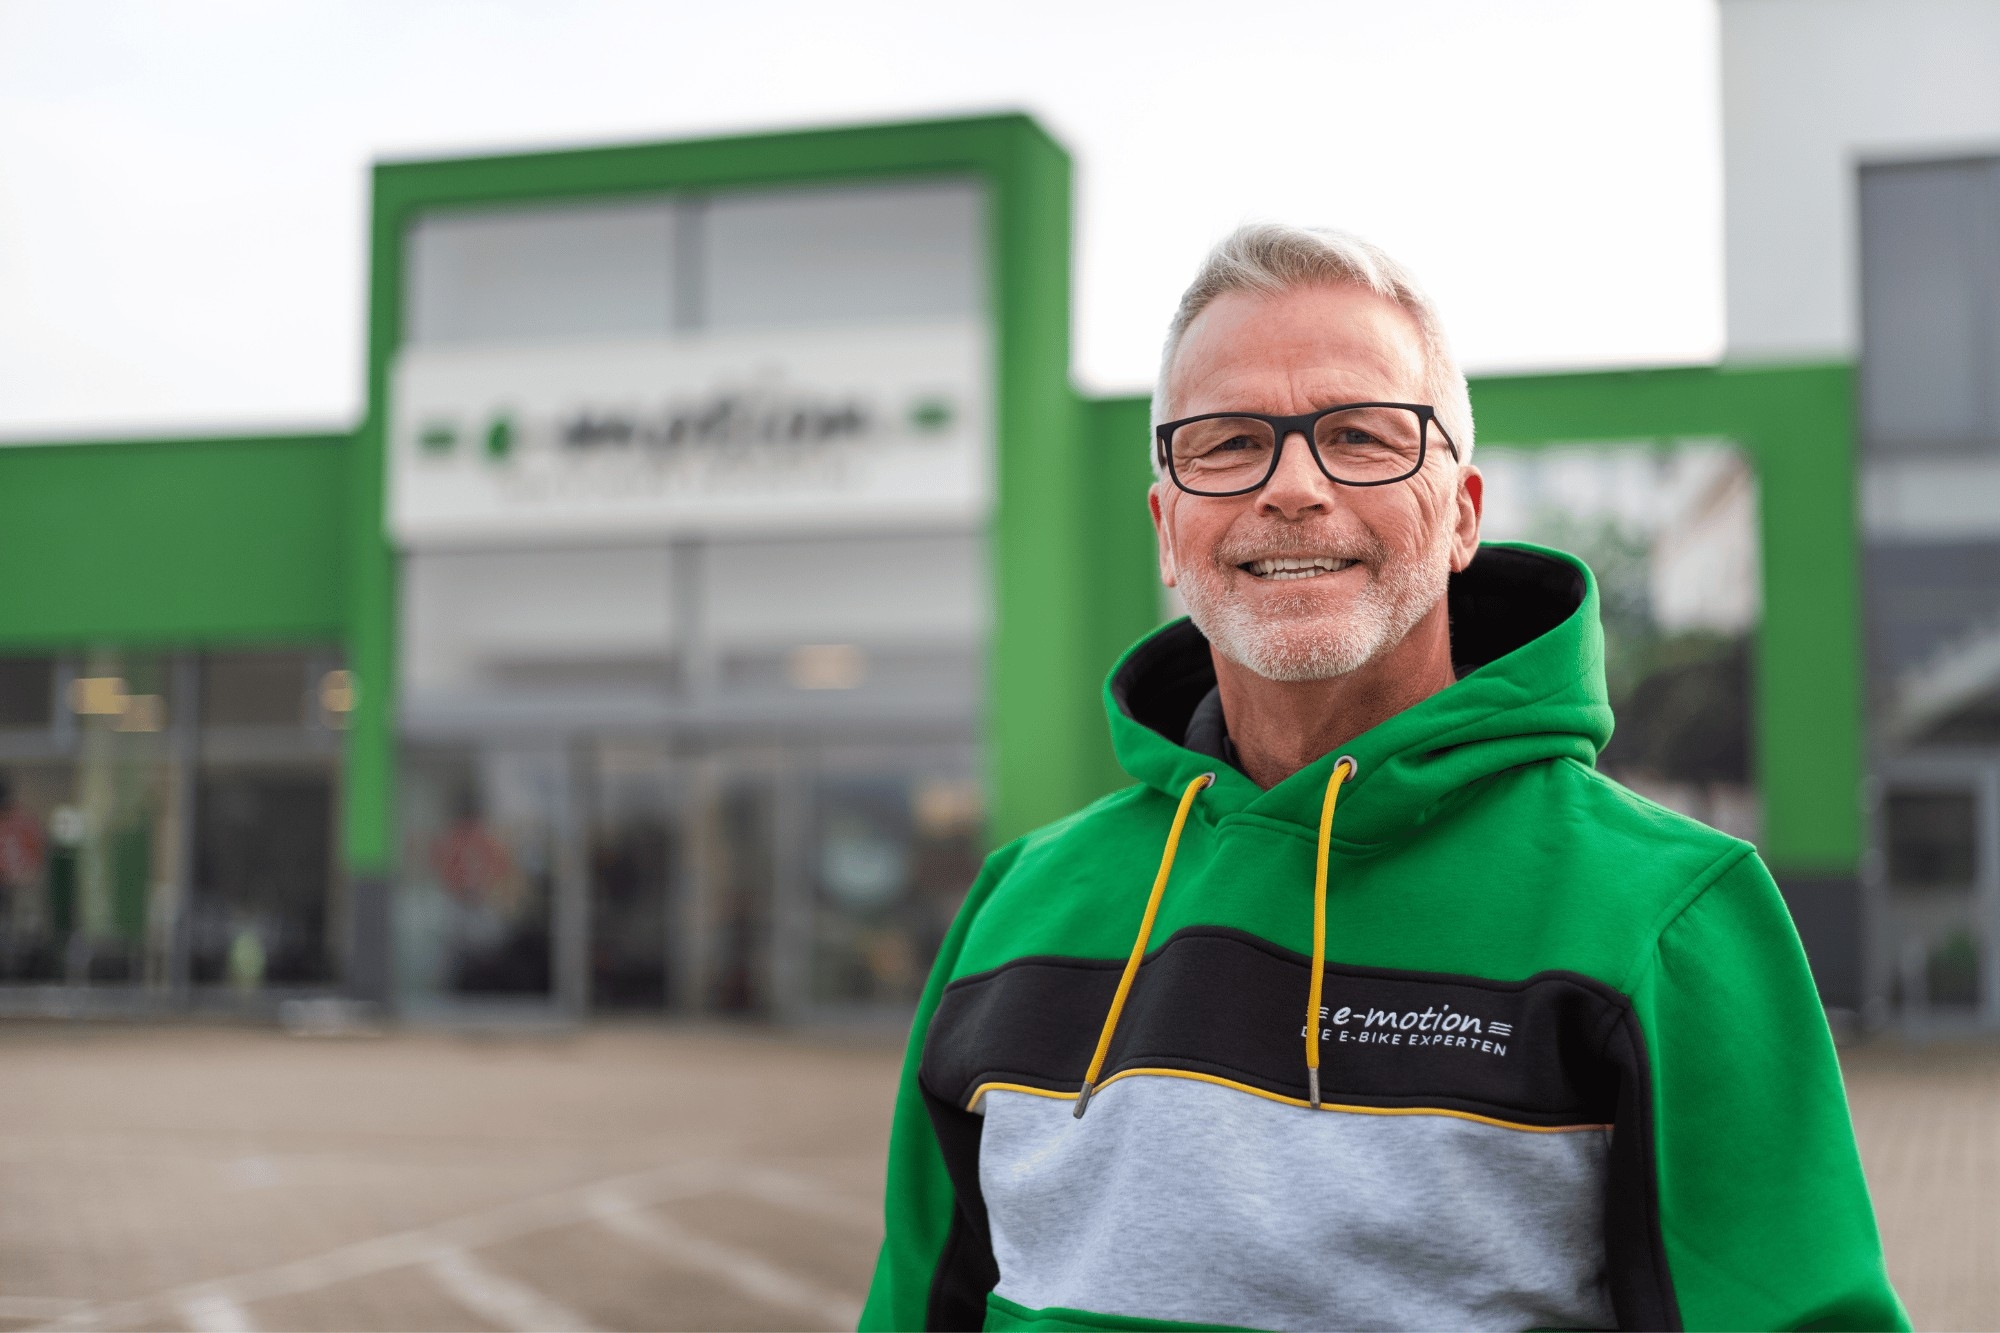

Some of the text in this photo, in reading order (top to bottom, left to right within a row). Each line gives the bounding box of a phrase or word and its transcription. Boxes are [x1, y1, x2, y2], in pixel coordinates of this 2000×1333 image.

[1332, 1004, 1482, 1034] e-motion
[1339, 1030, 1402, 1045] E-BIKE
[1408, 1033, 1507, 1057] EXPERTEN
